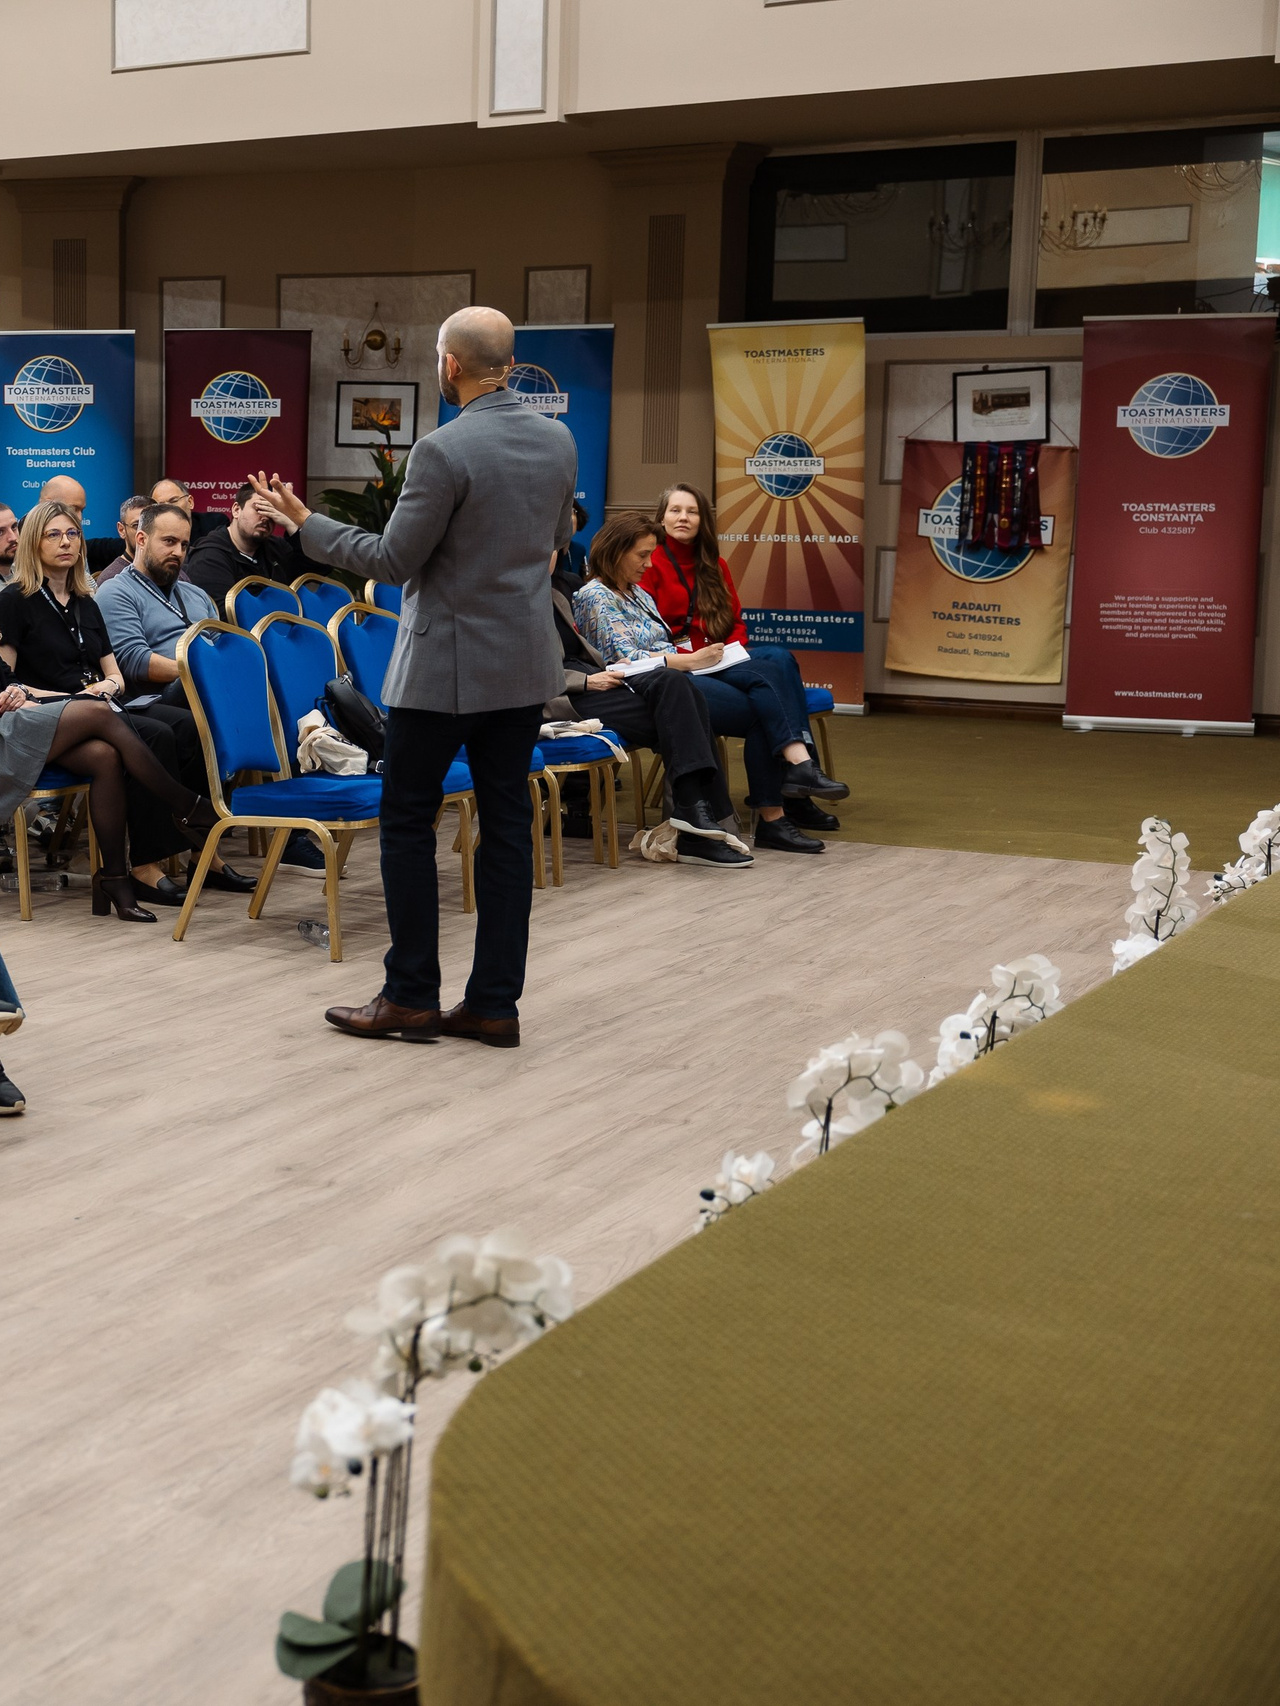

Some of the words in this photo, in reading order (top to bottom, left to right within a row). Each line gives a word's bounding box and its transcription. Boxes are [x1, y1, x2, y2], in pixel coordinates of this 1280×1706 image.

[744, 348, 825, 358] TOASTMASTERS
[8, 387, 90, 395] TOASTMASTERS
[516, 395, 565, 404] MASTERS
[194, 401, 278, 409] TOASTMASTERS
[1121, 407, 1226, 418] TOASTMASTERS
[6, 447, 70, 456] Toastmasters
[73, 447, 95, 455] Club
[26, 460, 76, 468] Bucharest
[748, 459, 821, 467] TOASTMASTERS
[574, 491, 585, 499] UB
[1122, 503, 1216, 512] TOASTMASTERS
[1139, 526, 1158, 534] Club
[754, 534, 800, 542] LEADERS
[804, 535, 825, 543] ARE
[829, 535, 859, 543] MADE
[1161, 595, 1198, 603] supportive
[952, 601, 1001, 612] RADAUTI
[1129, 602, 1157, 610] learning
[770, 613, 855, 624] Toastmasters
[932, 611, 1021, 626] TOASTMASTERS
[946, 631, 965, 639] Club
[968, 633, 1003, 641] 5418924
[937, 646, 971, 656] Radauti,
[973, 649, 1010, 658] Romania
[1114, 689, 1203, 700] www.toastmasters.org
